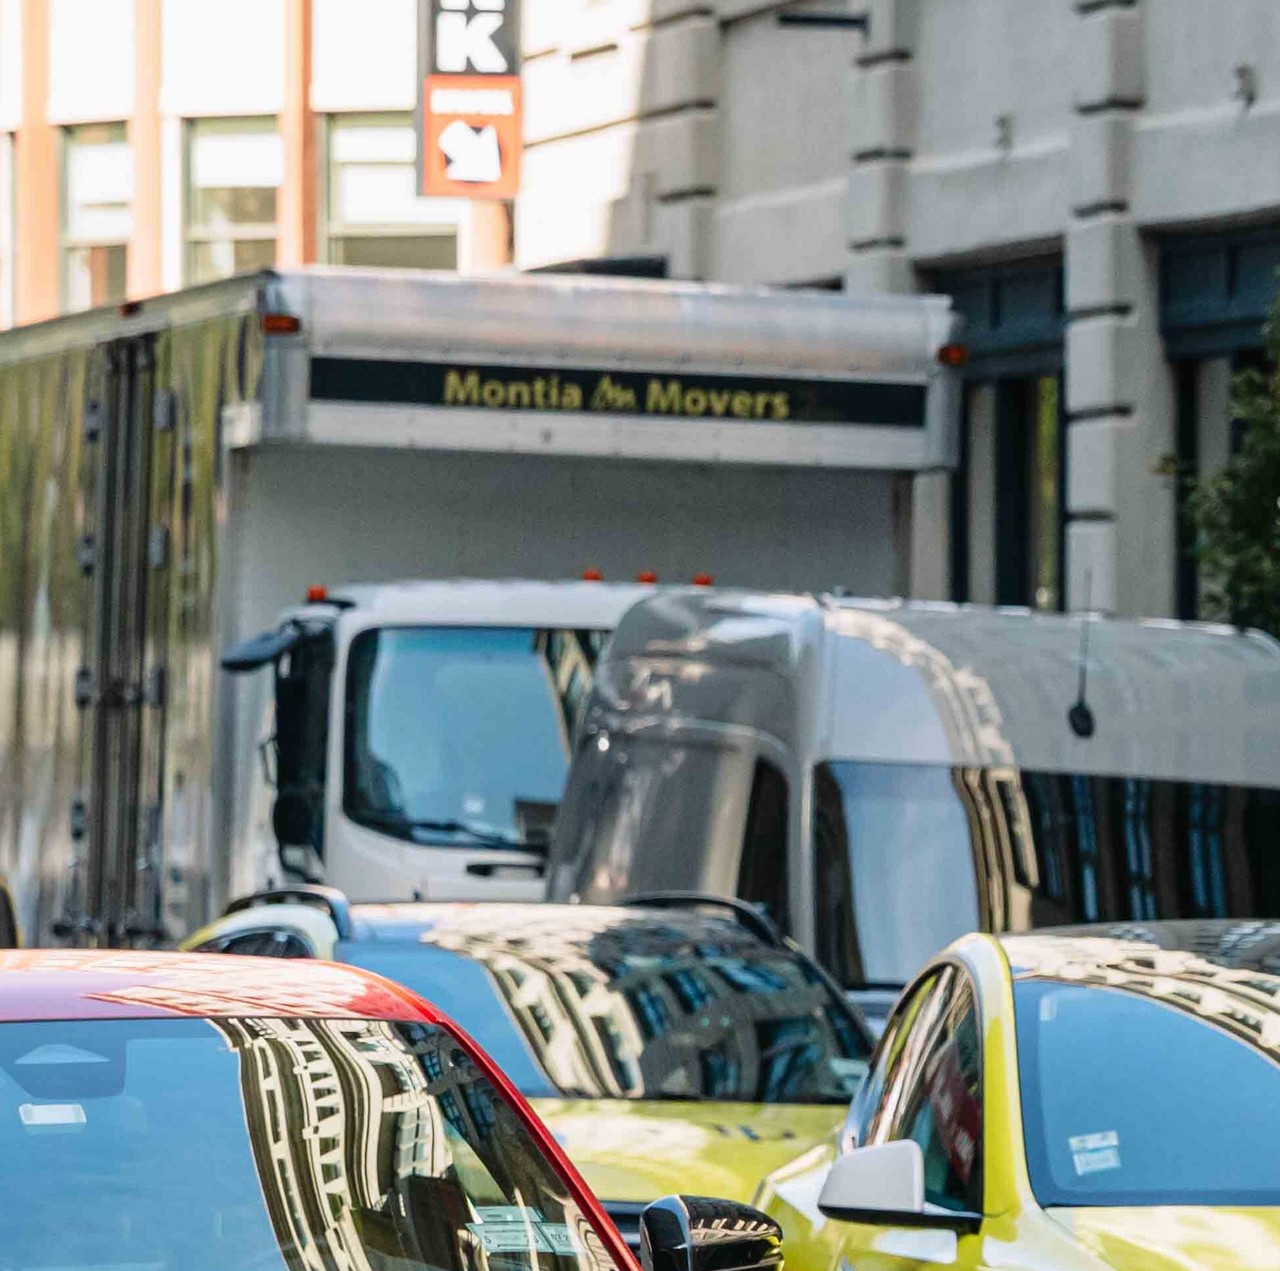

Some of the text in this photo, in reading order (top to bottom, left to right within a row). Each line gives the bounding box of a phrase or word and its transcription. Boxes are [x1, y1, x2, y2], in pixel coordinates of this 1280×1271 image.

[437, 0, 508, 73] K
[444, 370, 789, 420] Montia Movers
